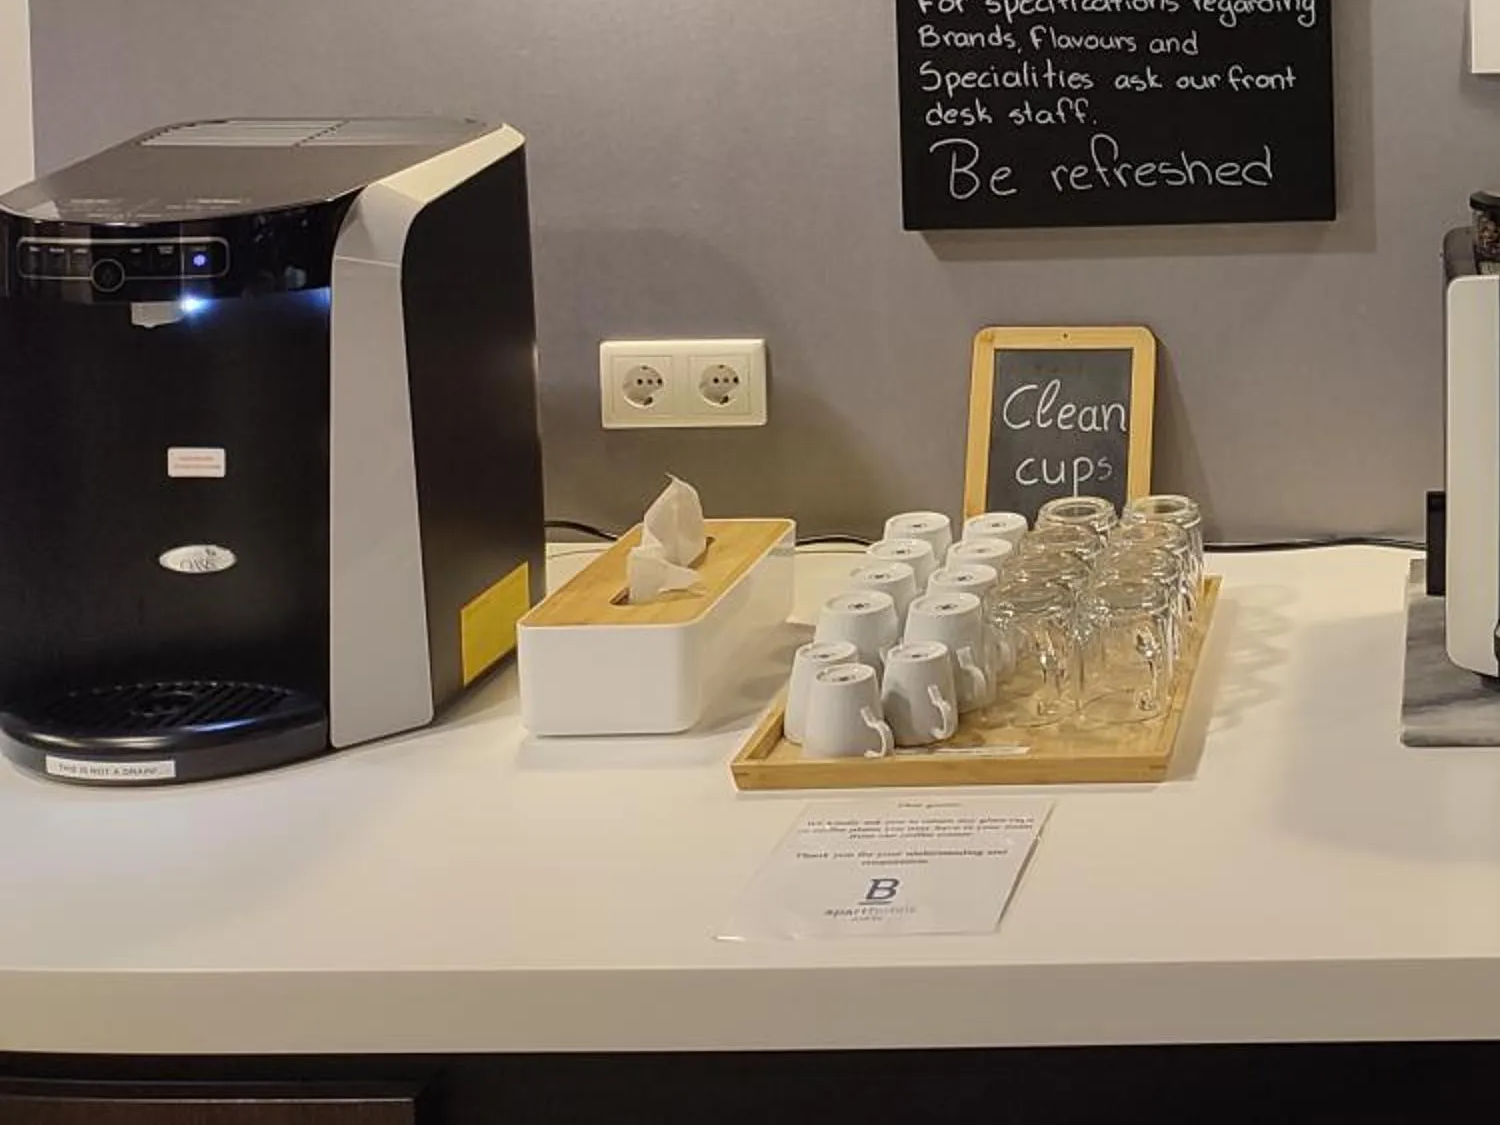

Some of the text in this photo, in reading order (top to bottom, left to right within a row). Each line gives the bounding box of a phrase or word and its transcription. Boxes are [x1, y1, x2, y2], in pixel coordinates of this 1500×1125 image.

[918, 25, 1021, 53] Brands,
[1150, 31, 1198, 55] and
[920, 59, 1296, 97] Specialities ask our front
[926, 97, 1098, 125] desk staff.
[930, 134, 1272, 199] Be refreshed
[1004, 379, 1126, 431] Clean
[1015, 456, 1113, 497] cups
